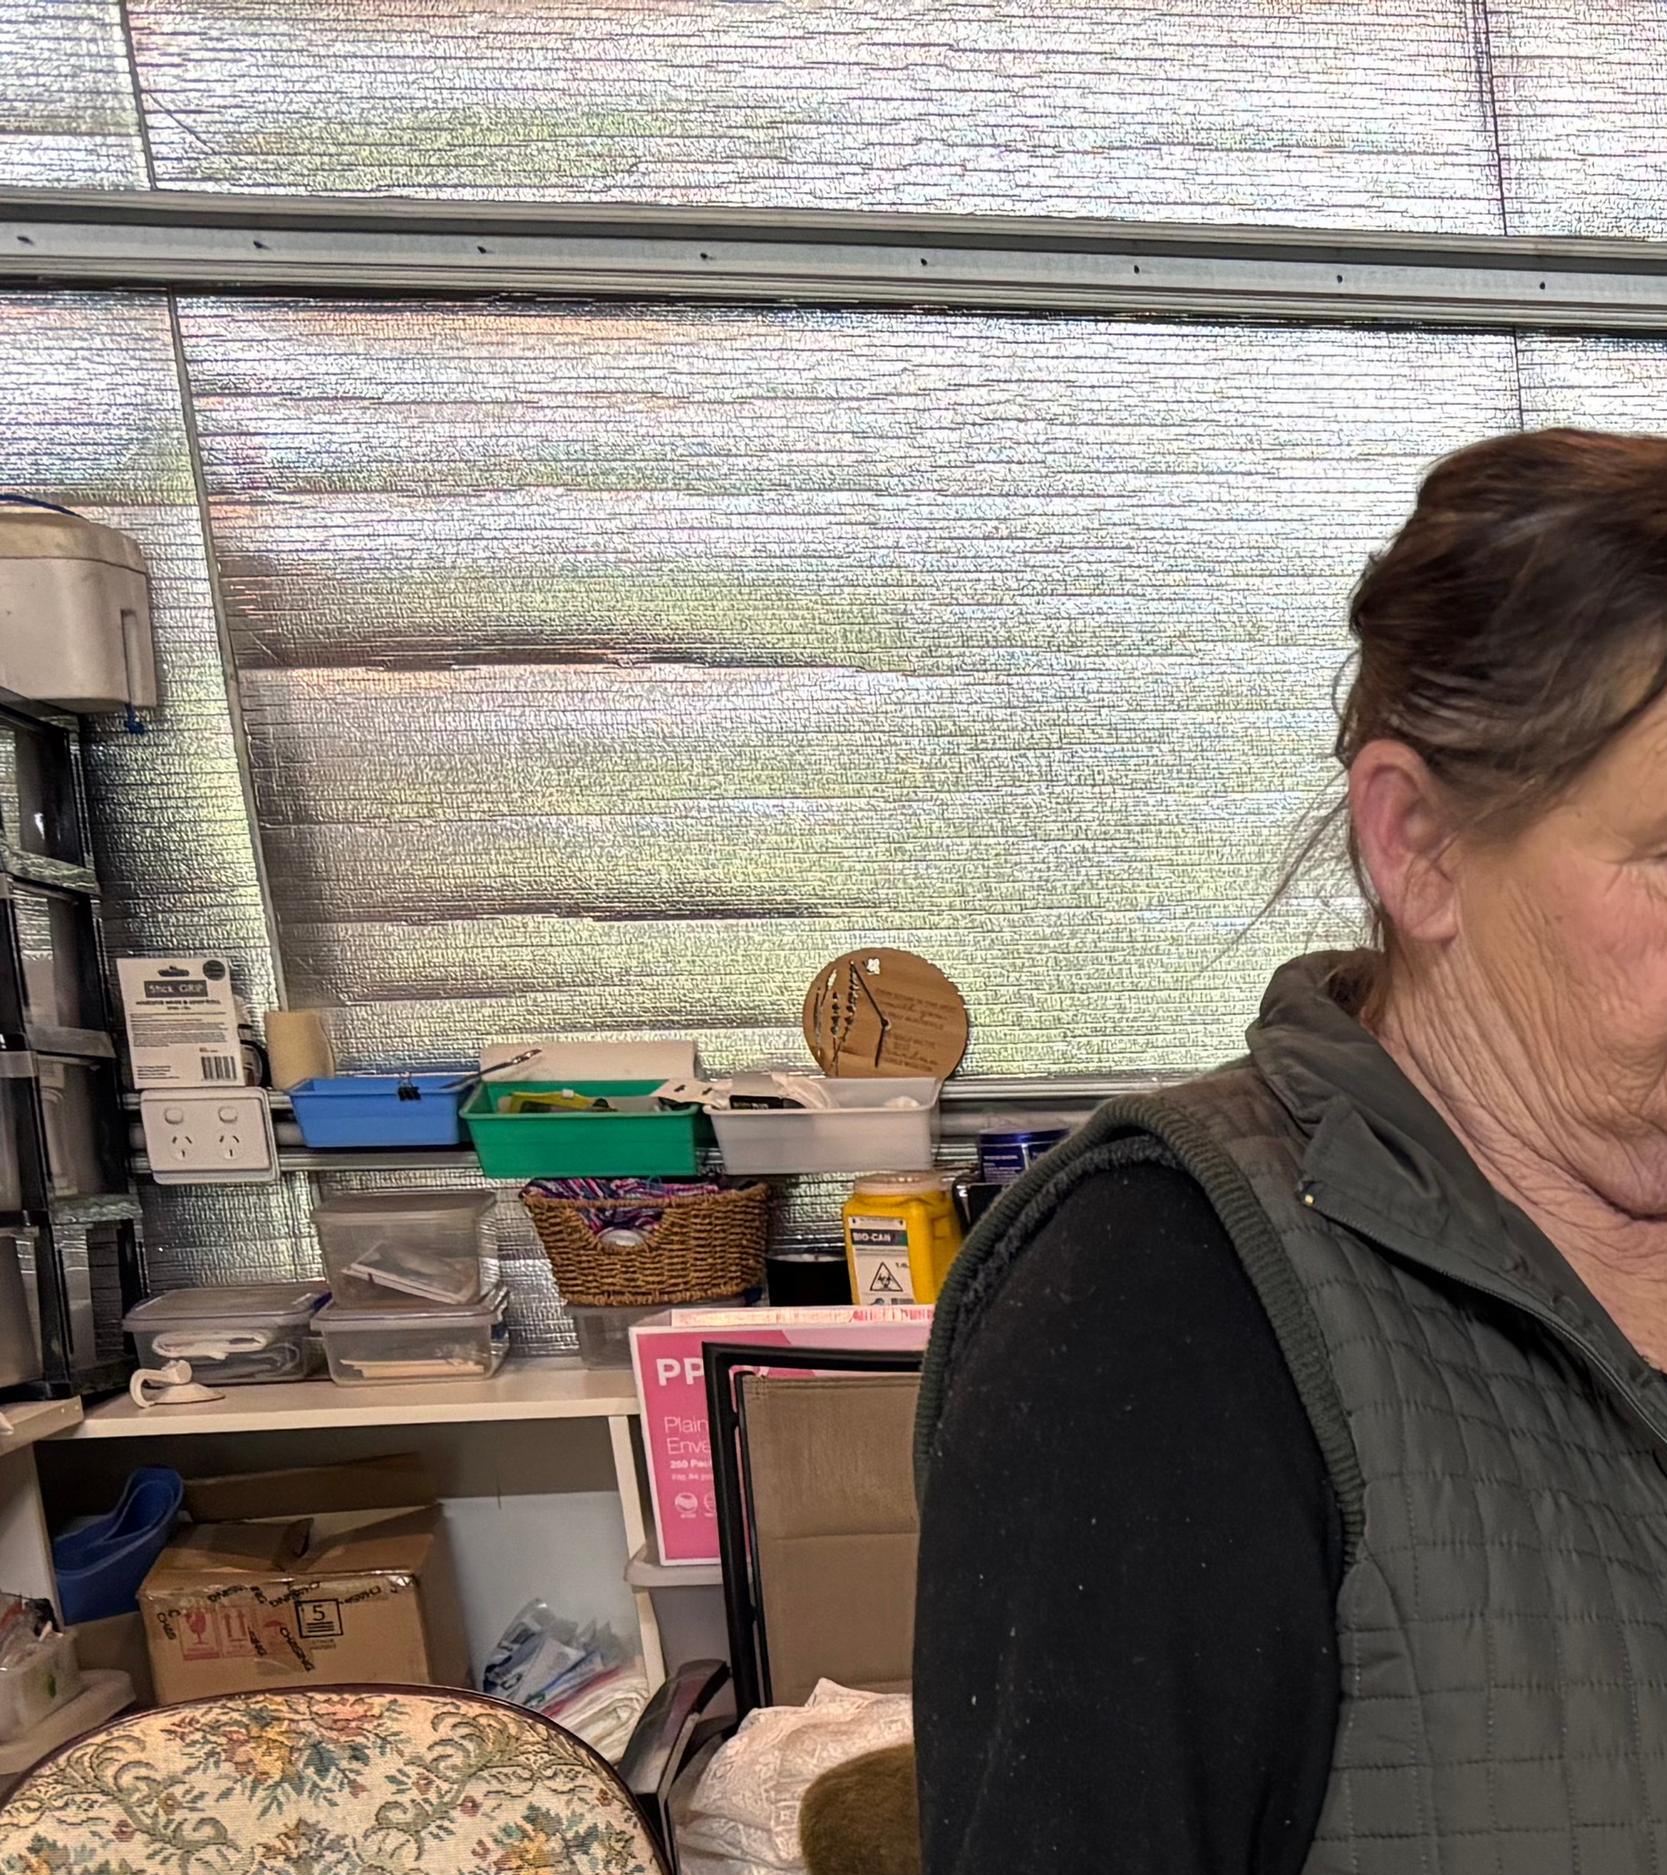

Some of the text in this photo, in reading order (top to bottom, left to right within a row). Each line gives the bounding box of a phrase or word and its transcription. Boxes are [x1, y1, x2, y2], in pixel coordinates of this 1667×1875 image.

[656, 1357, 705, 1386] PP
[664, 1416, 708, 1434] Plain
[666, 1437, 711, 1455] Enve
[313, 1605, 326, 1621] 5
